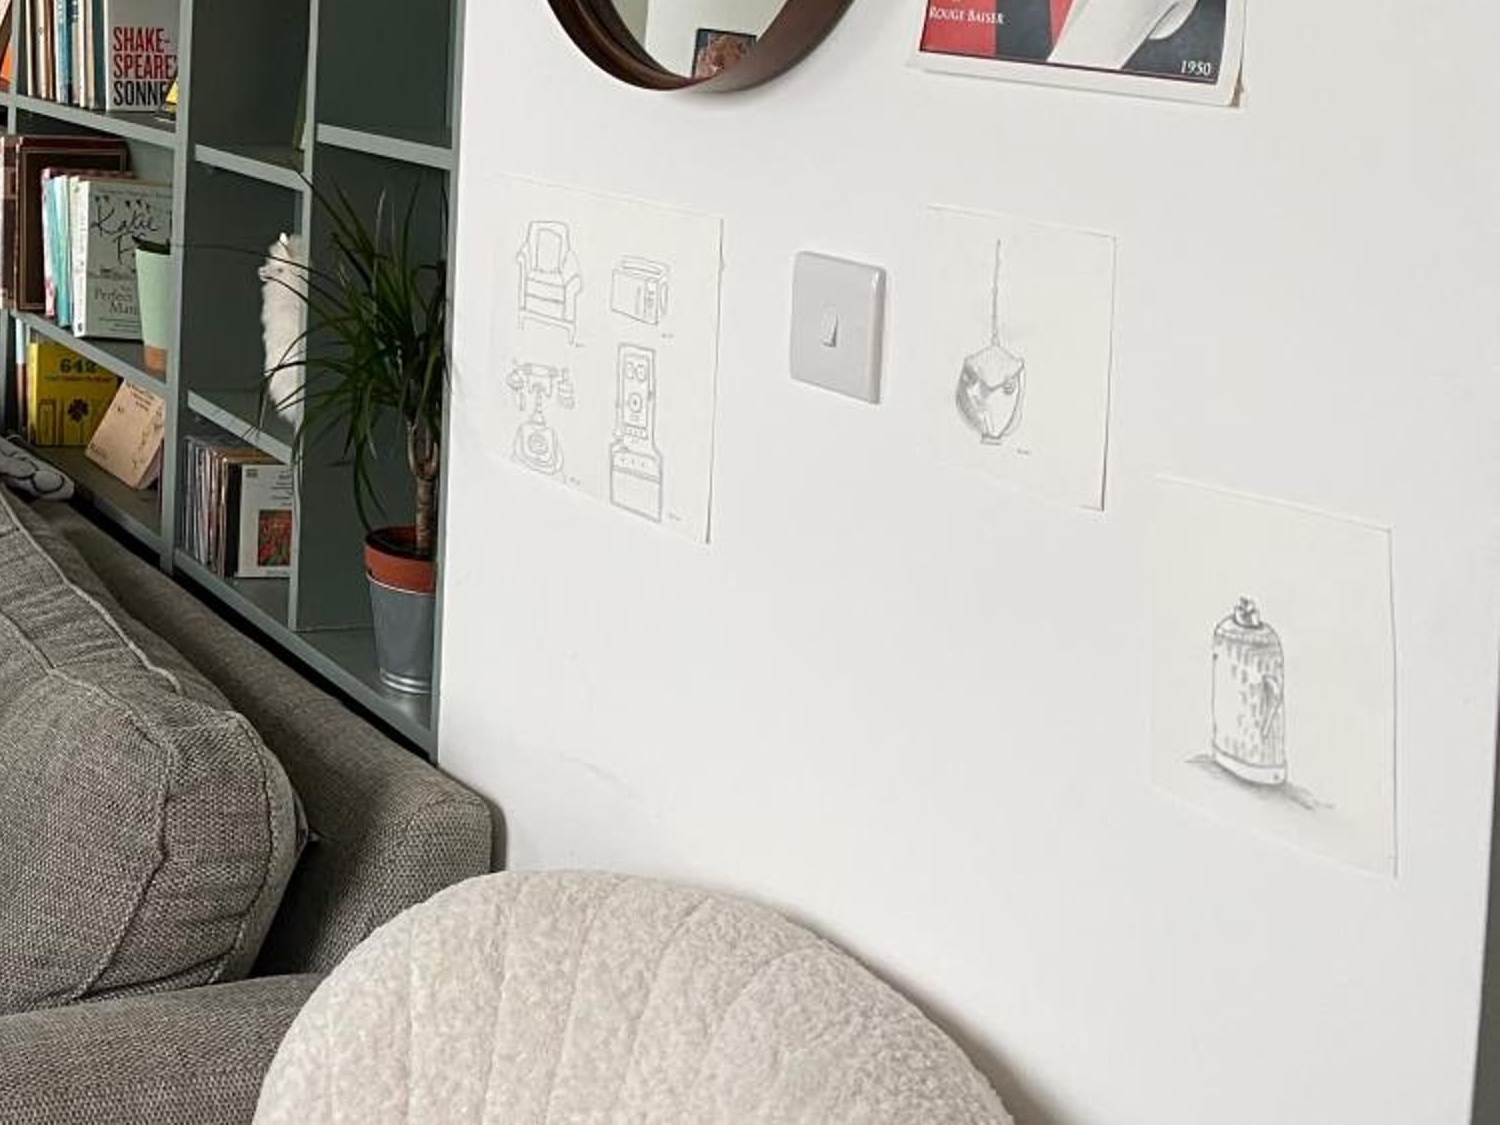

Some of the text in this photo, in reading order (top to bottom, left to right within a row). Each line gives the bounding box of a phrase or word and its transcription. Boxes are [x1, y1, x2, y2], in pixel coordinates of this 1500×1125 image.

[929, 6, 1004, 25] ROUGE BAISER
[113, 26, 171, 53] SHAKE-
[113, 53, 178, 80] SPEARE'
[1181, 60, 1211, 76] 1950
